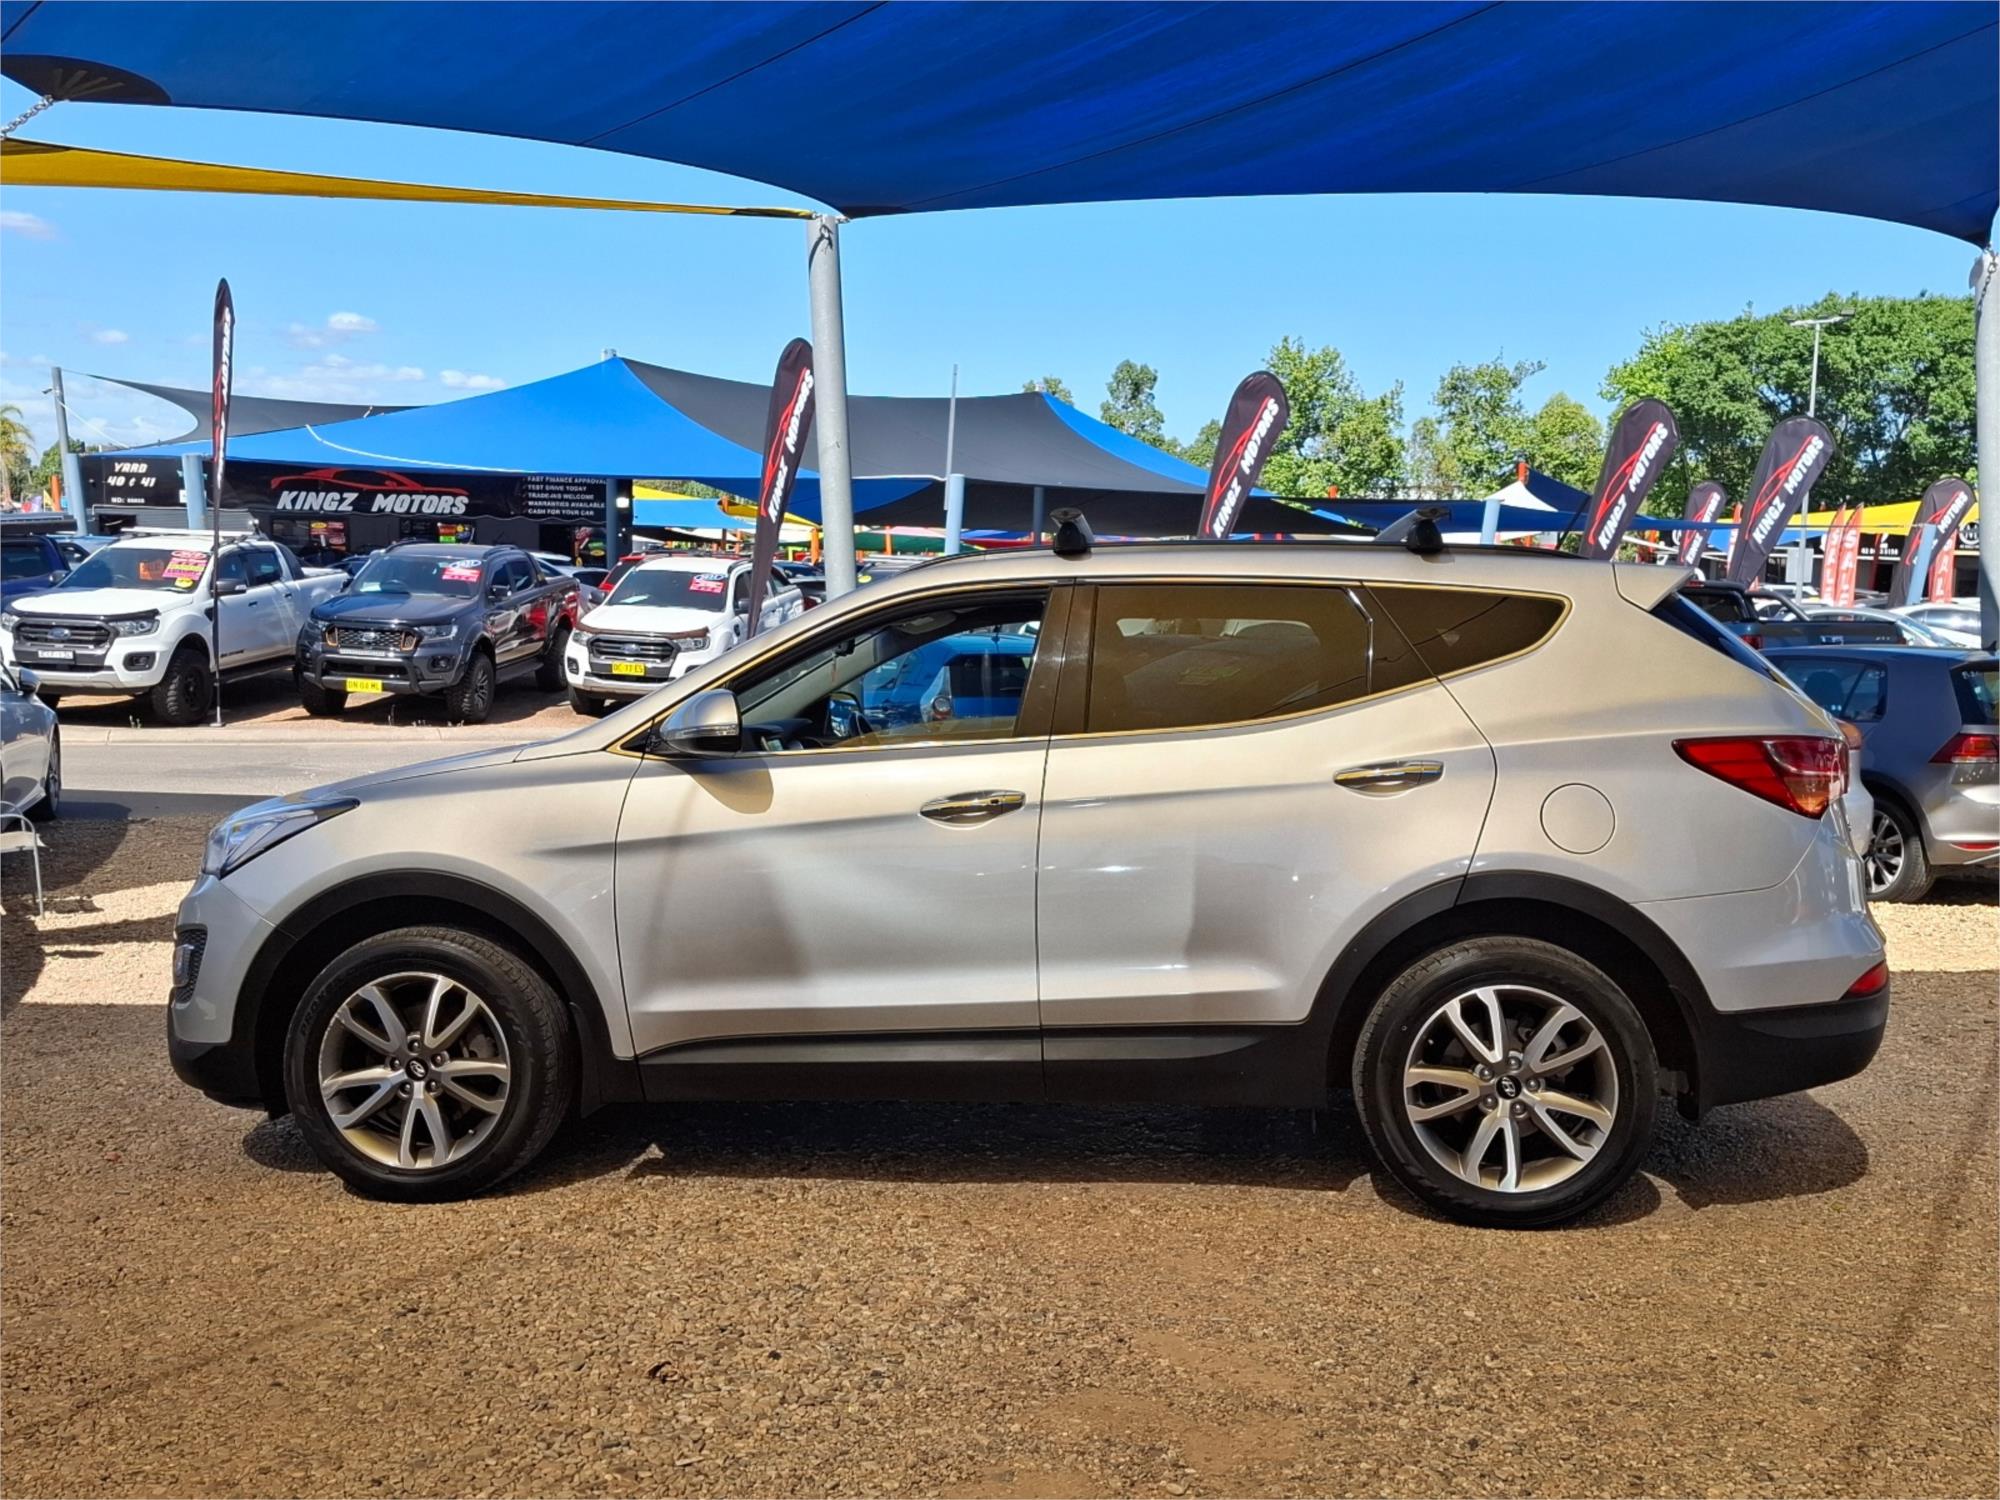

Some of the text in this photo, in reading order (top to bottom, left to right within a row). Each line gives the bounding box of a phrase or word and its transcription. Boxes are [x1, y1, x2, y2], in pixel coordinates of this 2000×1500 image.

[114, 462, 148, 474] YARD
[767, 369, 814, 524] KINGZ MOTORS
[107, 475, 126, 487] 40
[140, 477, 157, 487] 41
[545, 476, 573, 484] FINANCE
[1213, 398, 1280, 539] KINGZ MOTORS
[1598, 422, 1669, 551] KINGZ MOTORS
[1752, 434, 1825, 545] KINGZ MOTORS
[276, 490, 470, 515] KINGZ MOTORS
[1937, 491, 1968, 534] MOTORS
